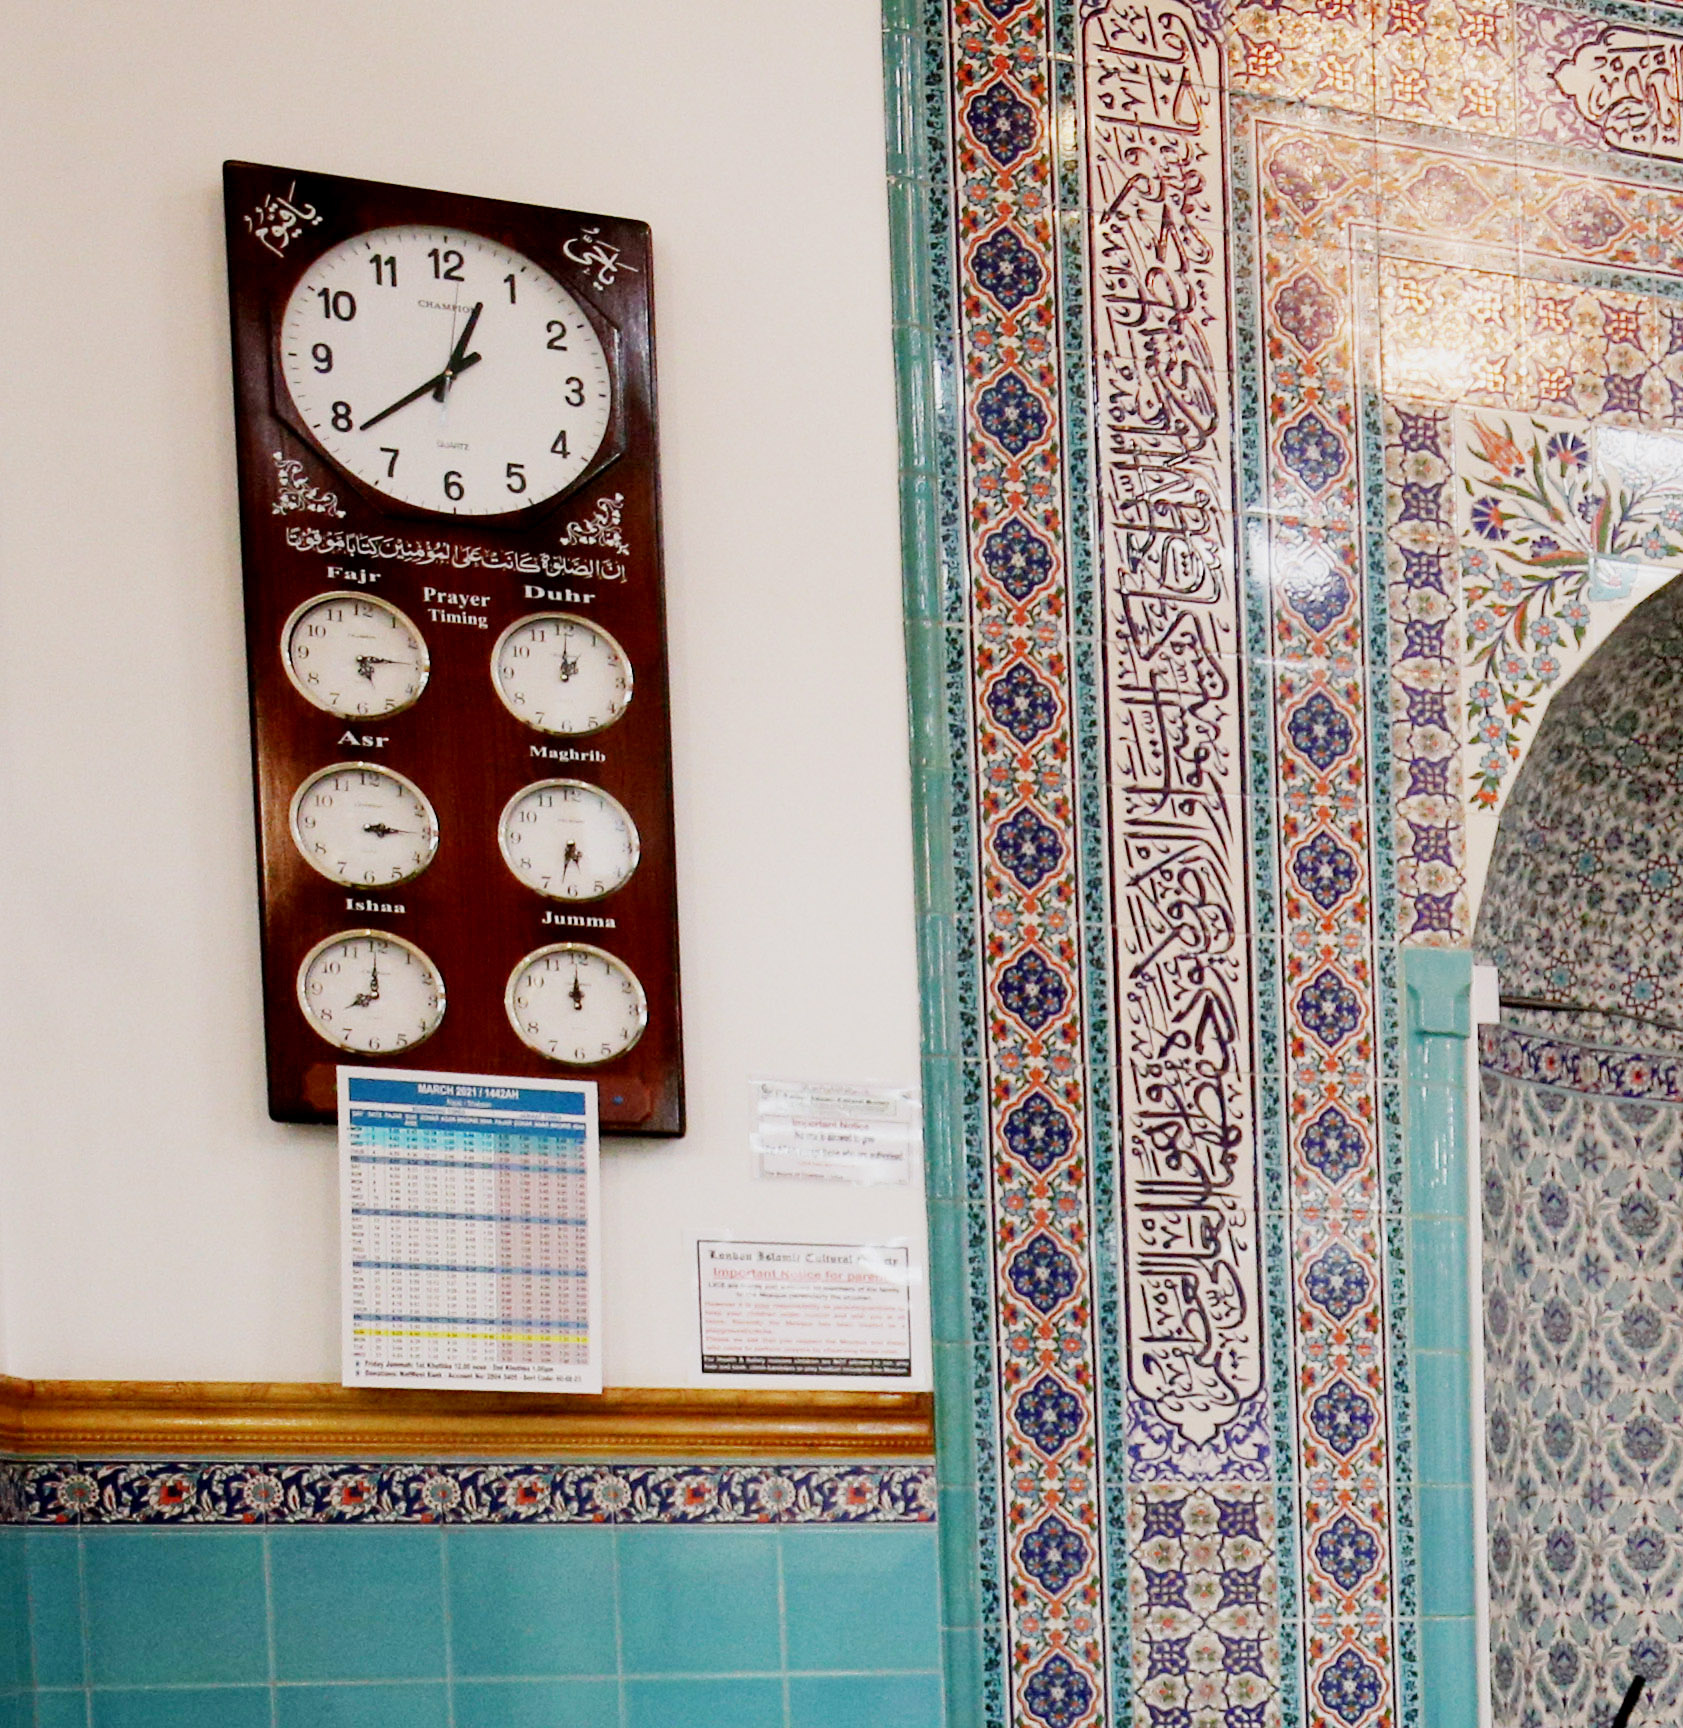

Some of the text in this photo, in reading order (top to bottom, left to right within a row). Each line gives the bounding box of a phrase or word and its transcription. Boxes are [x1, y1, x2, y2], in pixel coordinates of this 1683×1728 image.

[369, 253, 399, 287] 11
[428, 248, 465, 282] 12
[504, 273, 517, 304] 1
[317, 289, 357, 322] 10
[546, 320, 568, 352] 2
[311, 342, 334, 375] 9
[564, 375, 586, 408] 3
[331, 401, 353, 434] 8
[550, 429, 571, 459] 4
[379, 447, 400, 478] 7
[443, 469, 465, 501] 6
[505, 462, 528, 494] 5
[326, 565, 382, 584] Fajr
[422, 586, 491, 608] Prayer
[523, 585, 597, 604] Duhr
[327, 609, 343, 622] 11
[353, 604, 373, 618] 12
[427, 607, 489, 630] Timing
[309, 624, 326, 638] 10
[531, 629, 545, 642] 11
[554, 624, 574, 637] 12
[513, 645, 530, 658] 10
[337, 731, 389, 748] Asr
[529, 745, 607, 763] Maghrib
[334, 778, 349, 791] 11
[360, 772, 380, 787] 12
[316, 795, 333, 808] 10
[538, 794, 553, 808] 11
[563, 789, 581, 803] 12
[520, 811, 537, 824] 10
[345, 898, 407, 915] Ishaa
[541, 910, 617, 929] Jumma
[342, 945, 358, 959] 11
[366, 940, 389, 955] 12
[544, 958, 560, 972] 11
[568, 952, 589, 966] 12
[322, 961, 341, 975] 10
[527, 975, 545, 989] 10
[418, 1083, 454, 1096] MARCH
[455, 1086, 478, 1098] 2021
[709, 1249, 752, 1261] London
[714, 1266, 776, 1281] Important
